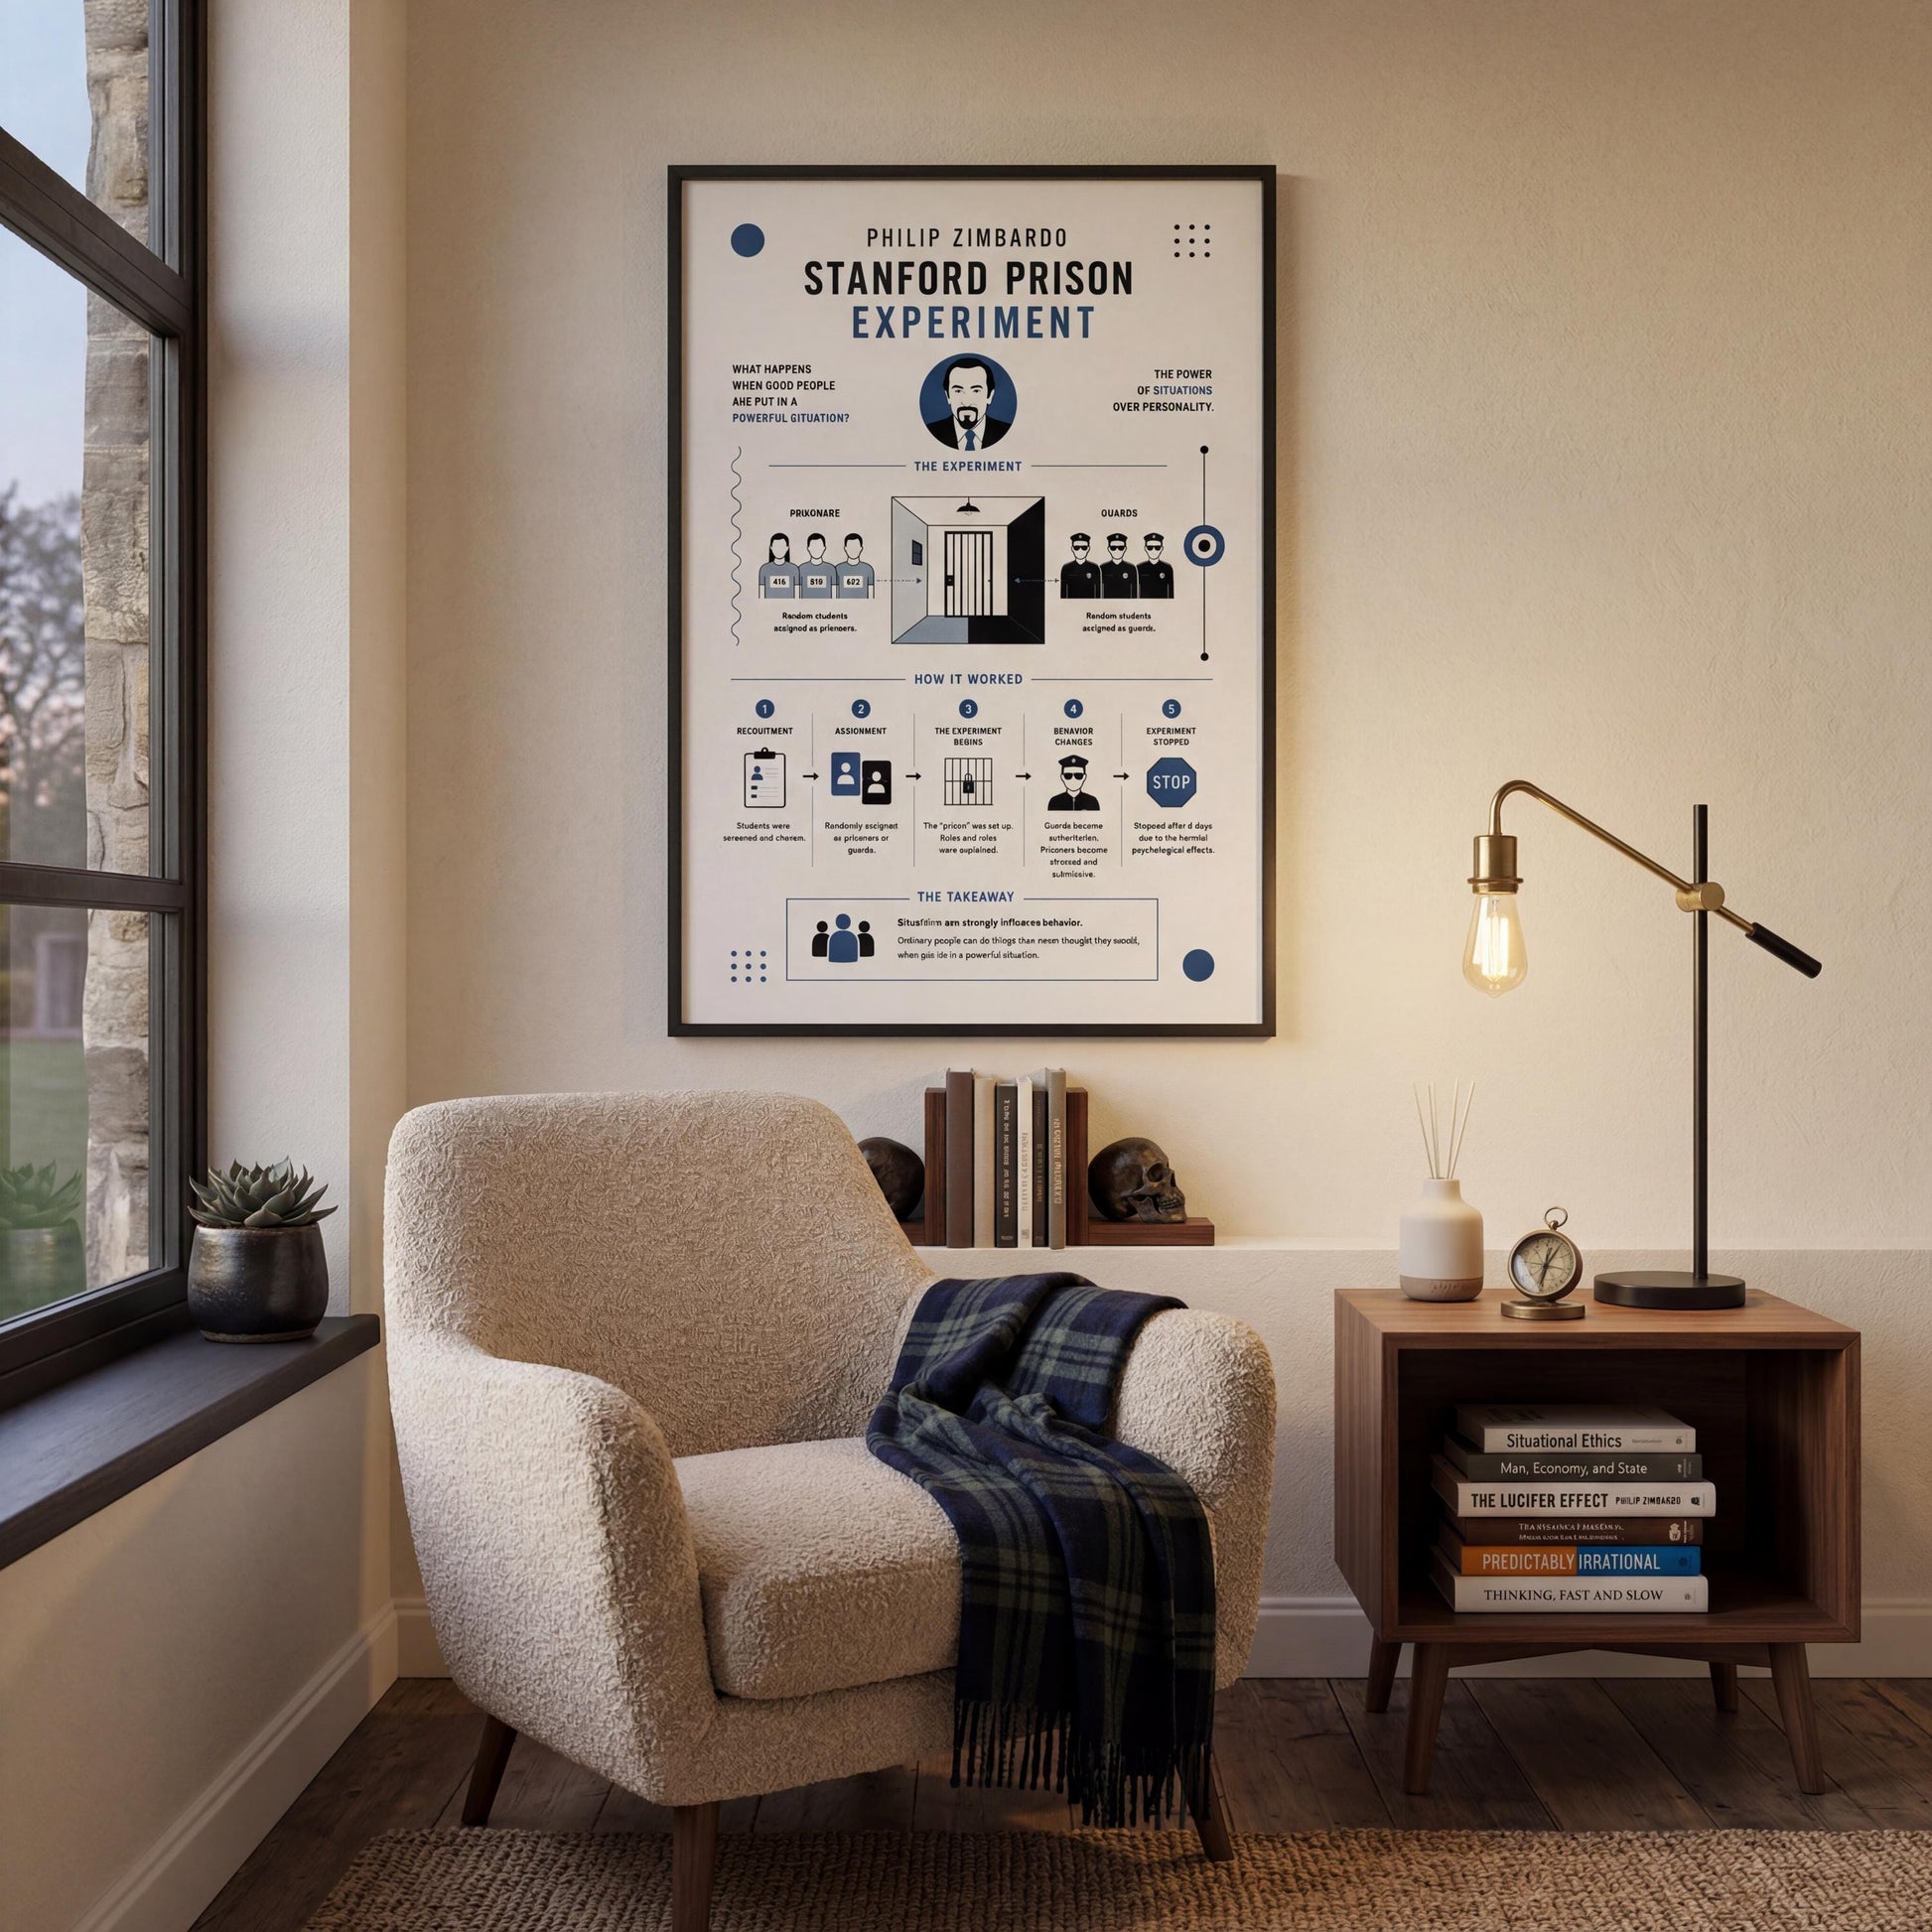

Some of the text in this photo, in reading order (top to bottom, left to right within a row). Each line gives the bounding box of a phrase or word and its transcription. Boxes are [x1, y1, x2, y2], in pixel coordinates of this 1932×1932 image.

[867, 227, 1066, 248] PHILIP ZIMBARDO
[804, 260, 1133, 296] STANFORD PRISON
[852, 305, 1095, 340] EXPERIMENT
[732, 363, 812, 374] WHAT HAPPENS
[1154, 368, 1212, 379] THE POWER
[732, 380, 836, 391] WHEN GOOD PEOPLE
[1137, 385, 1213, 396] OF SITUATIONS
[754, 396, 775, 407] PUT
[776, 396, 788, 407] IN
[790, 396, 798, 407] A
[1112, 401, 1214, 412] OVER PERSONALITY.
[732, 412, 788, 423] POWERFUL
[913, 461, 1023, 472] THE EXPERIMENT
[914, 673, 1024, 685] HOW IT WORKED
[761, 704, 767, 715] 1
[857, 703, 865, 715] 2
[965, 703, 972, 715] 3
[1069, 704, 1077, 715] 4
[1168, 703, 1175, 715] 5
[934, 727, 1003, 736] THE EXPERIMENT
[1146, 727, 1197, 736] EXPERIMENT
[1054, 738, 1093, 747] CHANGES
[1153, 738, 1190, 747] STOPPED
[1153, 774, 1190, 790] STOP
[736, 821, 770, 830] Students
[922, 821, 938, 830] The
[1001, 823, 1014, 832] up.
[939, 833, 998, 842] Roles and roles
[1185, 845, 1216, 855] effects.
[916, 891, 1015, 902] THE TAKEAWAY
[962, 917, 999, 929] strongly
[1041, 917, 1083, 927] behavior.
[979, 936, 991, 945] do
[1094, 936, 1112, 947] they
[897, 950, 919, 959] when
[949, 950, 957, 959] in
[965, 950, 1002, 961] powerful
[1506, 1433, 1622, 1449] Situational Ethics
[1500, 1460, 1648, 1478] Man, Economy, and State
[1470, 1492, 1609, 1509] THE LUCIFER EFFECT
[1482, 1553, 1661, 1571] PREDICTABLY IRRATIONAL
[1482, 1588, 1664, 1604] THINKING, FAST AND SLOW
